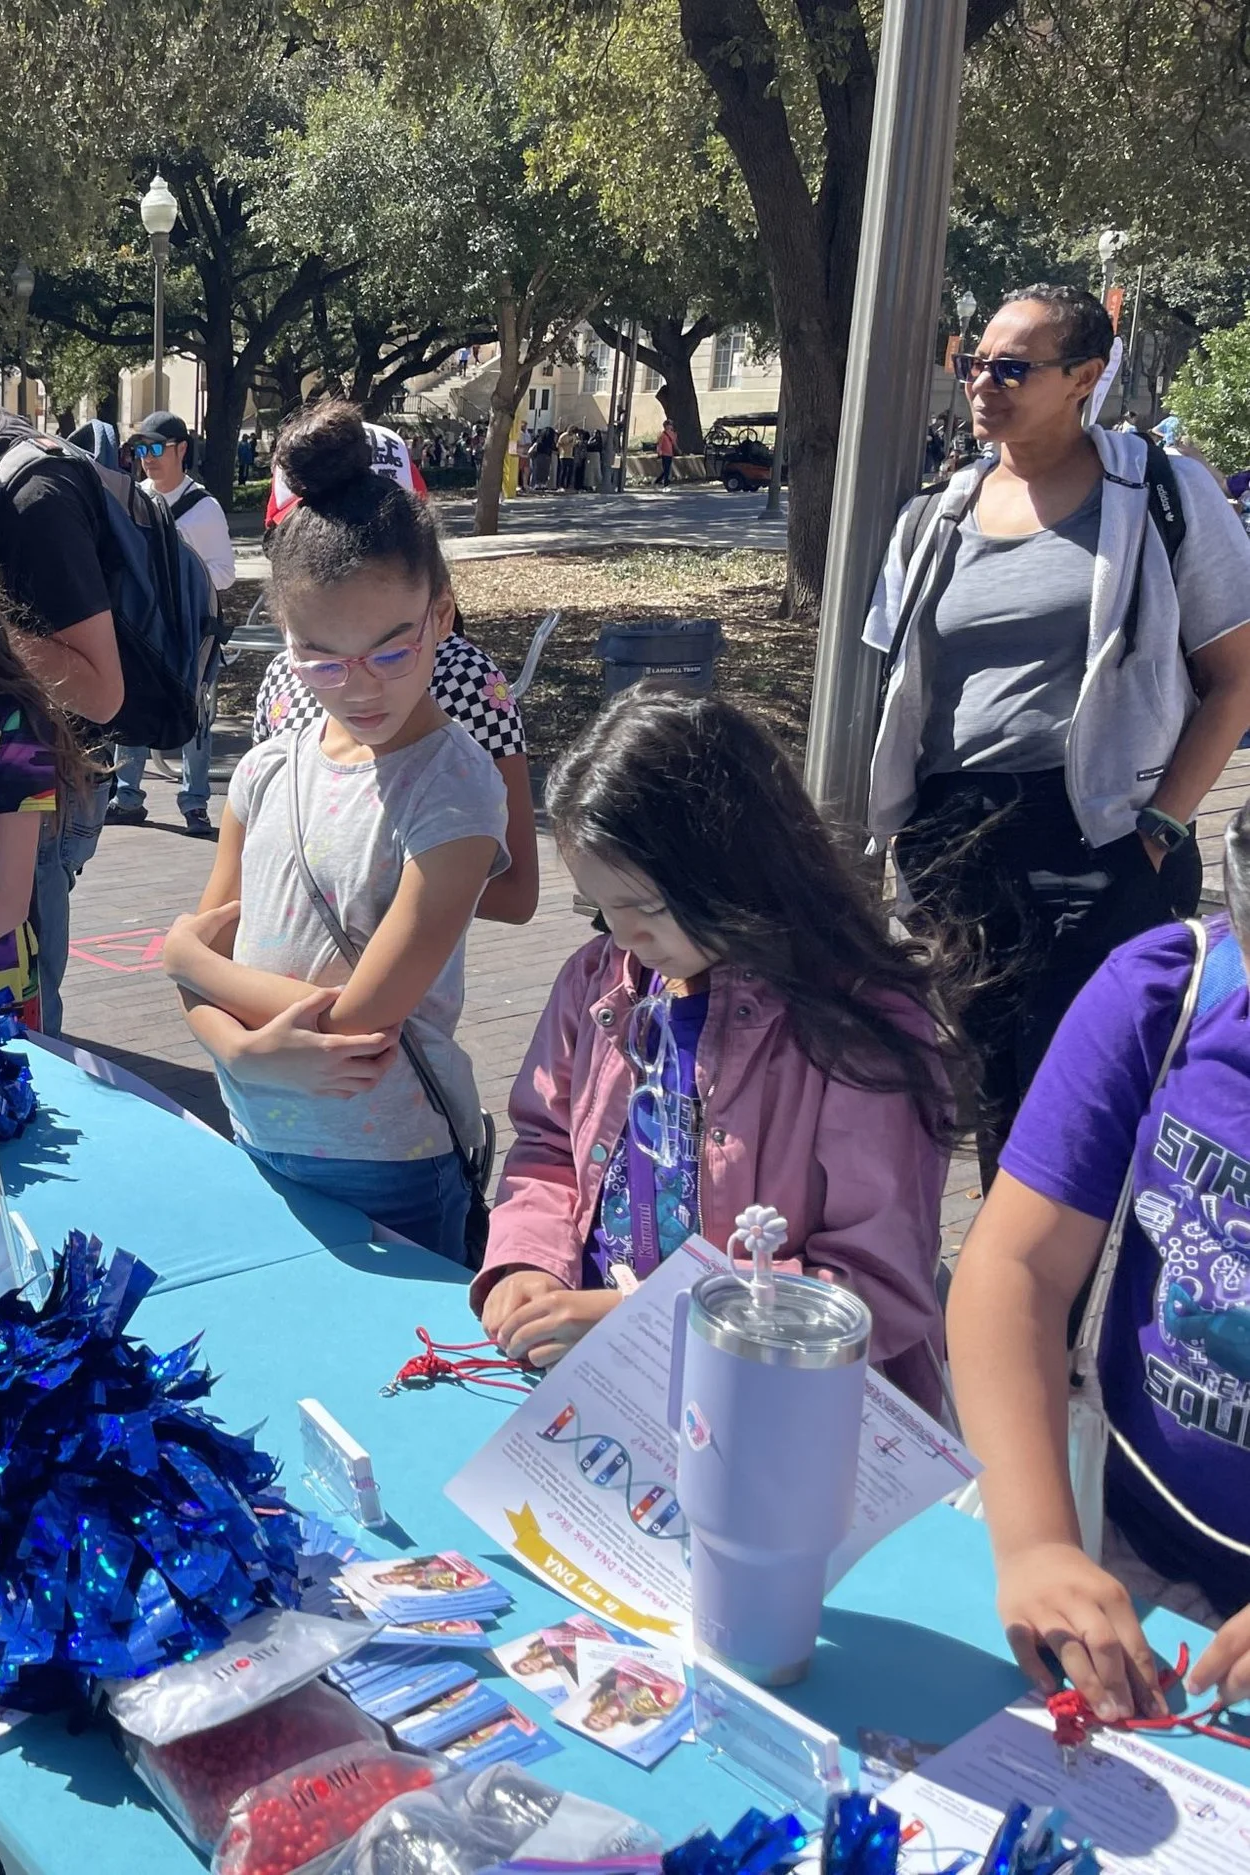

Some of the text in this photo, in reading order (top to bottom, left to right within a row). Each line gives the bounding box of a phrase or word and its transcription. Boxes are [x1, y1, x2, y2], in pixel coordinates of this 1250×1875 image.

[1156, 484, 1171, 512] adidas
[547, 1510, 572, 1533] like?
[573, 1531, 594, 1550] look
[594, 1549, 617, 1570] DNA
[544, 1554, 618, 1614] In my DNA
[617, 1569, 641, 1590] does
